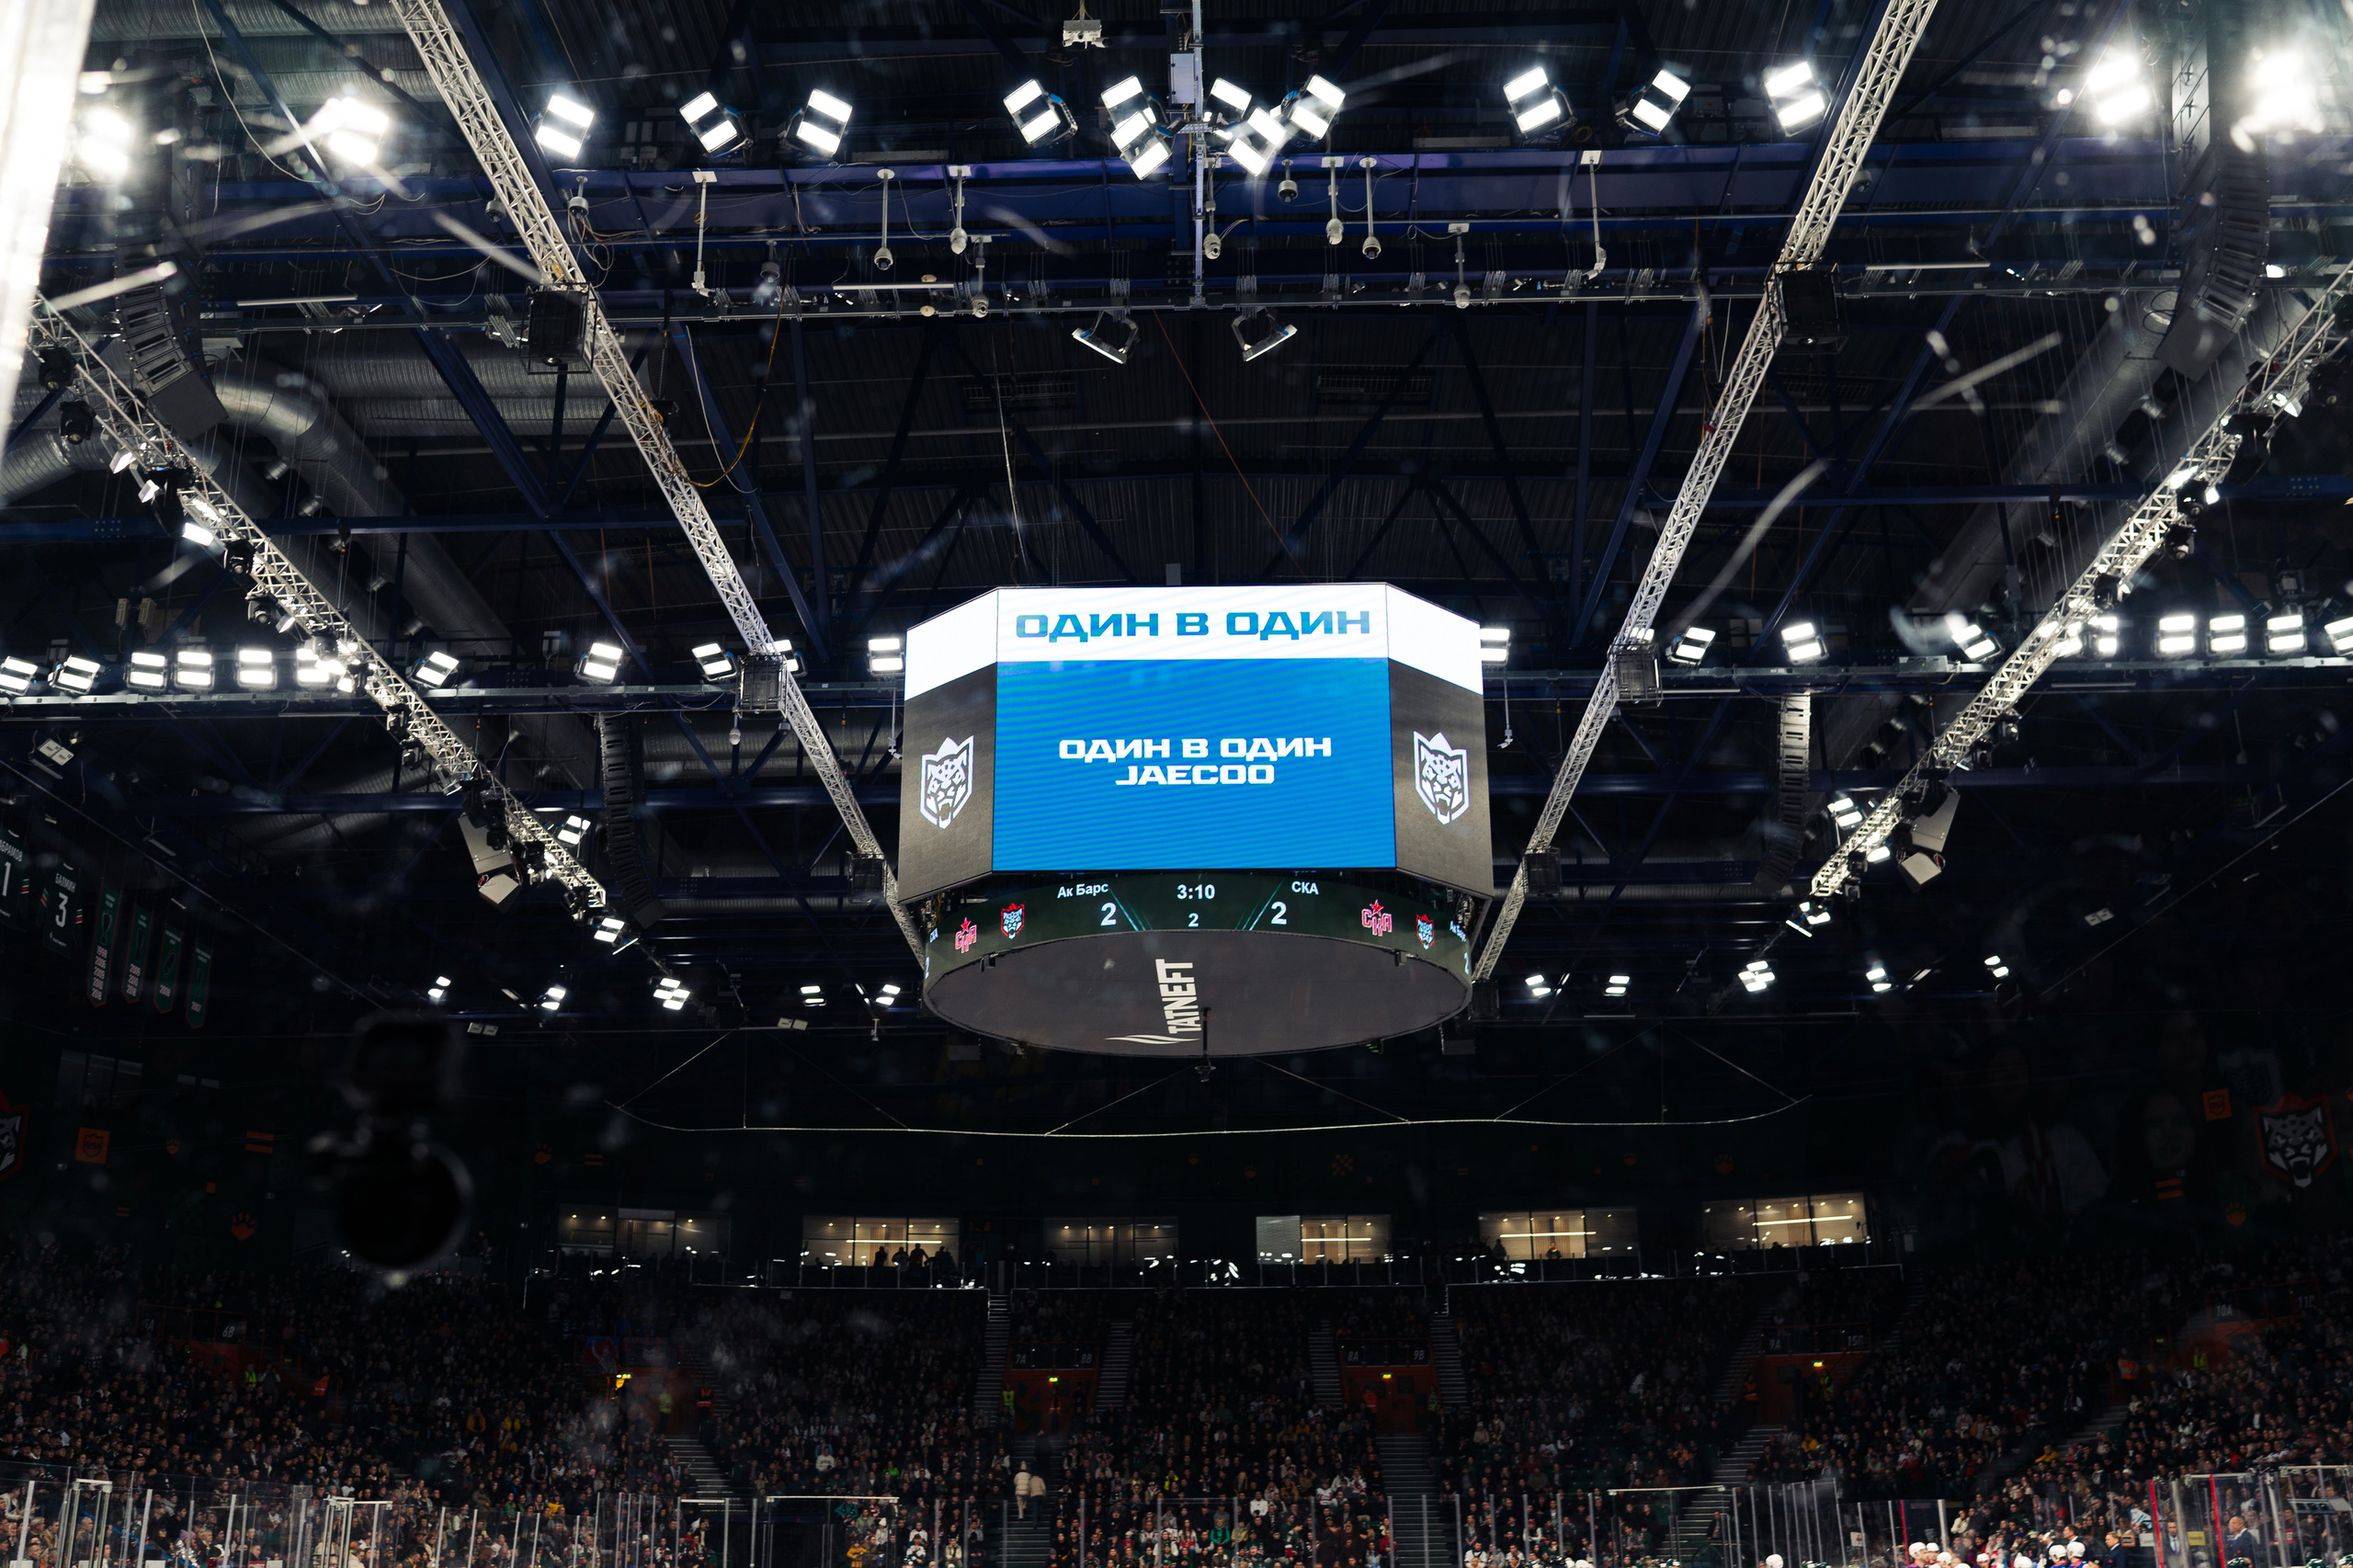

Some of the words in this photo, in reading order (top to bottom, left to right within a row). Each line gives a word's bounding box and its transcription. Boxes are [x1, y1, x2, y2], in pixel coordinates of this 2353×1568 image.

[1016, 613, 1159, 643] ОДИН
[1176, 612, 1209, 636] В
[1226, 610, 1370, 641] ОДИН
[1059, 738, 1170, 763] ОДИН
[1181, 738, 1209, 758] В
[1220, 737, 1332, 762] ОДИН
[1115, 764, 1275, 786] JAECOO
[2, 861, 11, 897] 1
[1057, 885, 1074, 898] Ак
[1075, 882, 1108, 897] Барс
[1176, 883, 1216, 900] 3:10
[1291, 880, 1319, 895] СКА
[55, 892, 68, 928] 3
[1100, 902, 1118, 926] 2
[1270, 901, 1288, 926] 2
[1188, 912, 1199, 927] 2
[1155, 959, 1202, 1034] TATNEFT
[2216, 1303, 2233, 1317] 10A
[222, 1325, 235, 1338] 6B
[1769, 1338, 1781, 1350] 9A
[1015, 1354, 1028, 1365] 7A
[1080, 1353, 1094, 1365] 8B
[1347, 1350, 1359, 1362] 8A
[1413, 1349, 1426, 1361] 9B
